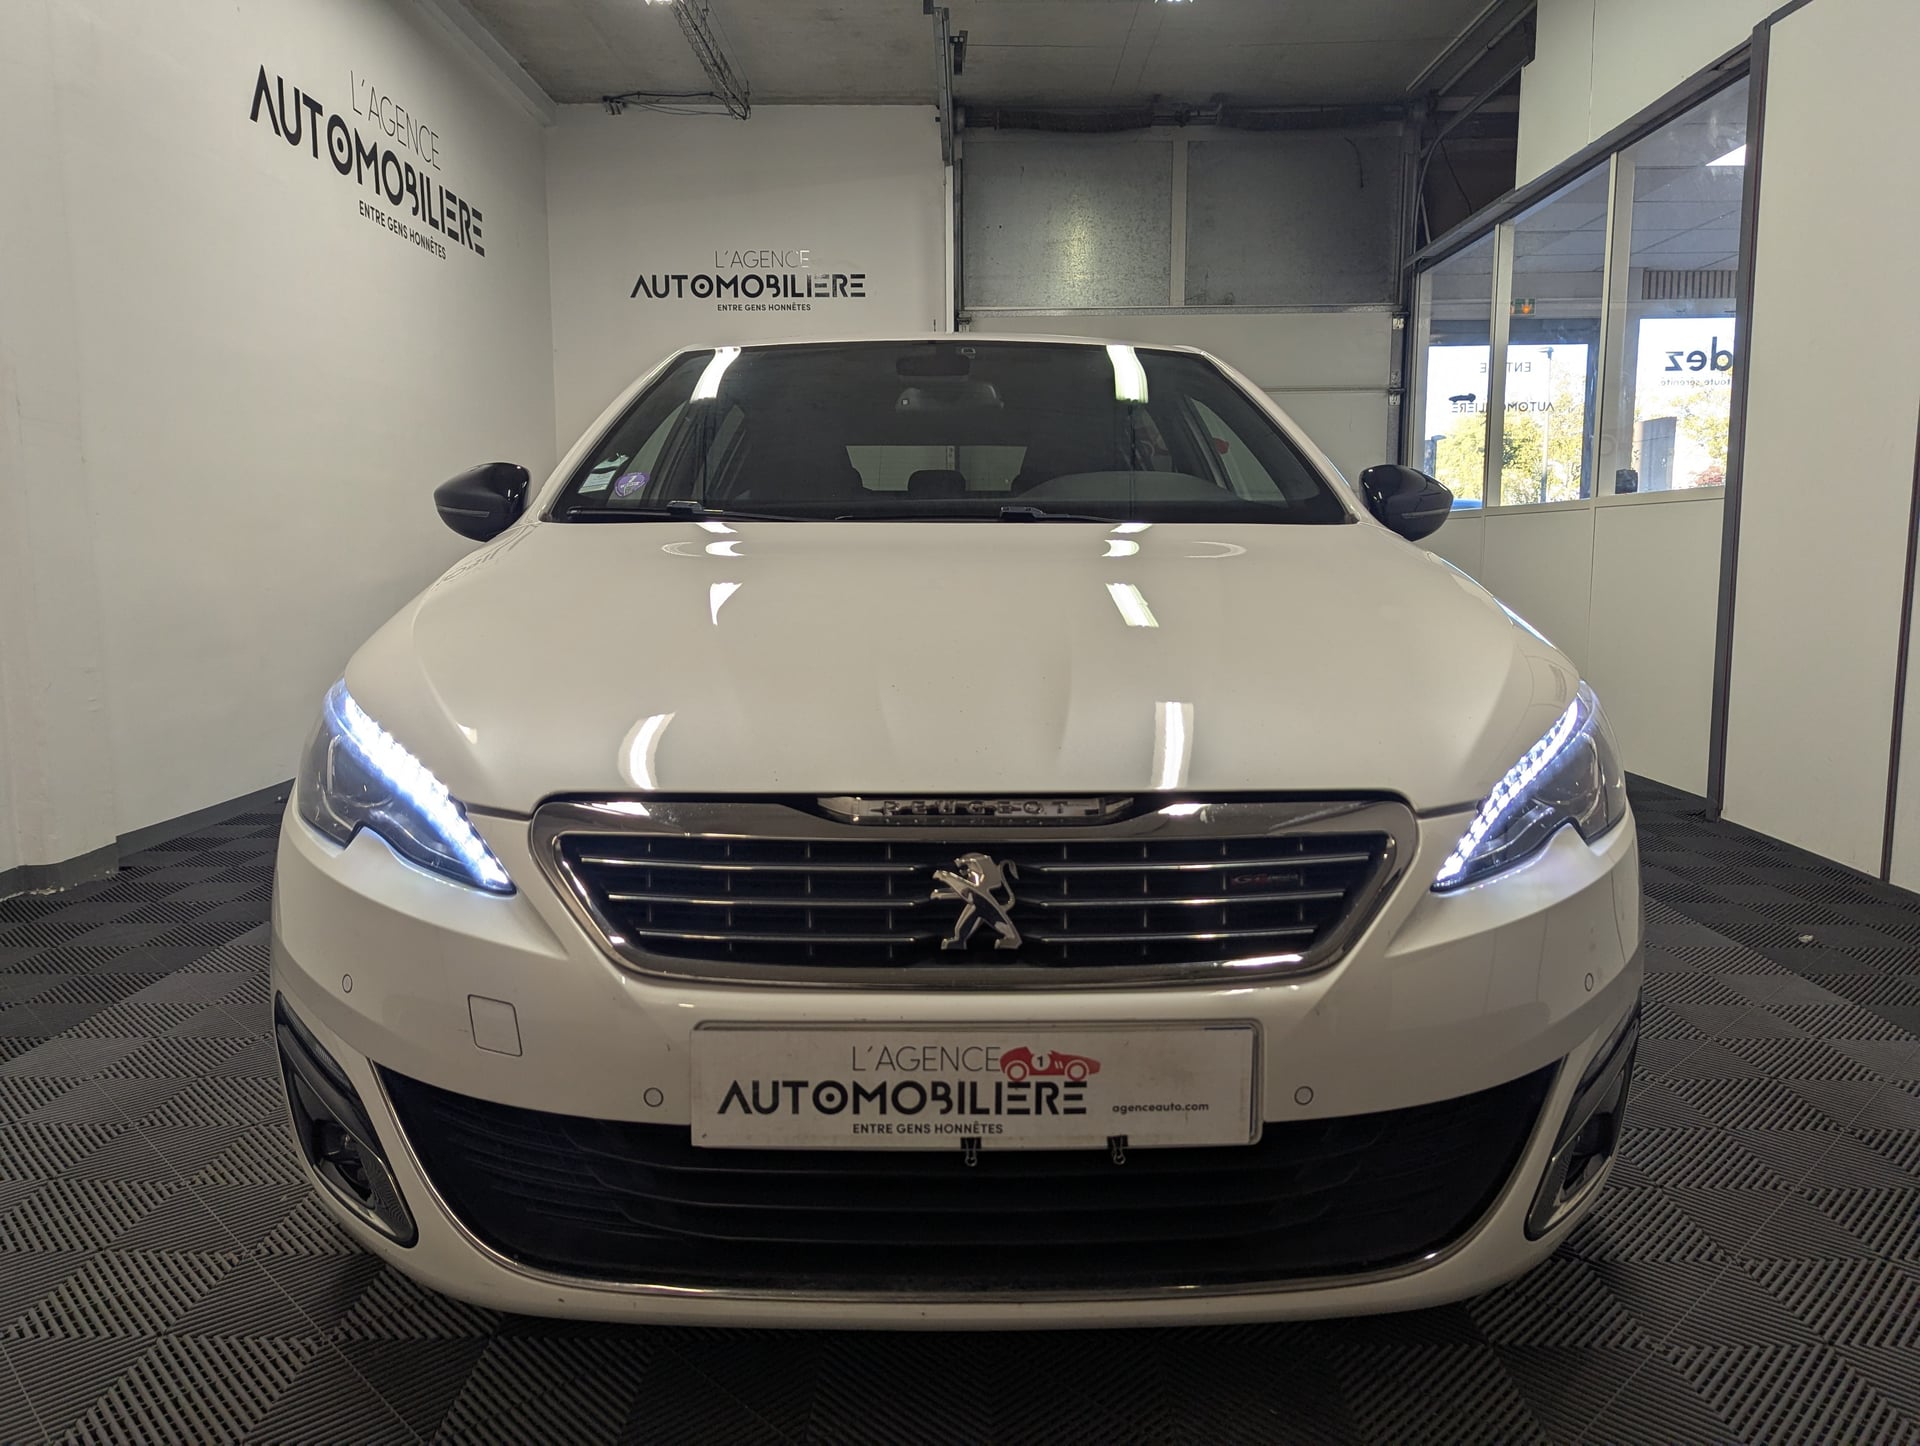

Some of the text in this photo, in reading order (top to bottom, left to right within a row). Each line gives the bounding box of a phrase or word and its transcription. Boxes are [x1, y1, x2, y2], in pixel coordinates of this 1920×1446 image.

[350, 70, 441, 171] L'AGENCE
[250, 64, 485, 257] AUTOMOBILIERE
[359, 200, 447, 260] ENTRE GENS HONNÊTES
[715, 250, 810, 268] L'AGENCE
[630, 274, 866, 298] AUTOMOBILIERE
[768, 301, 811, 311] HONNÊTES
[852, 1046, 1000, 1072] L'AGENCE
[1112, 1102, 1209, 1115] agenceauto.com
[853, 1120, 1003, 1134] ENTRE GENS HONNÊTES
